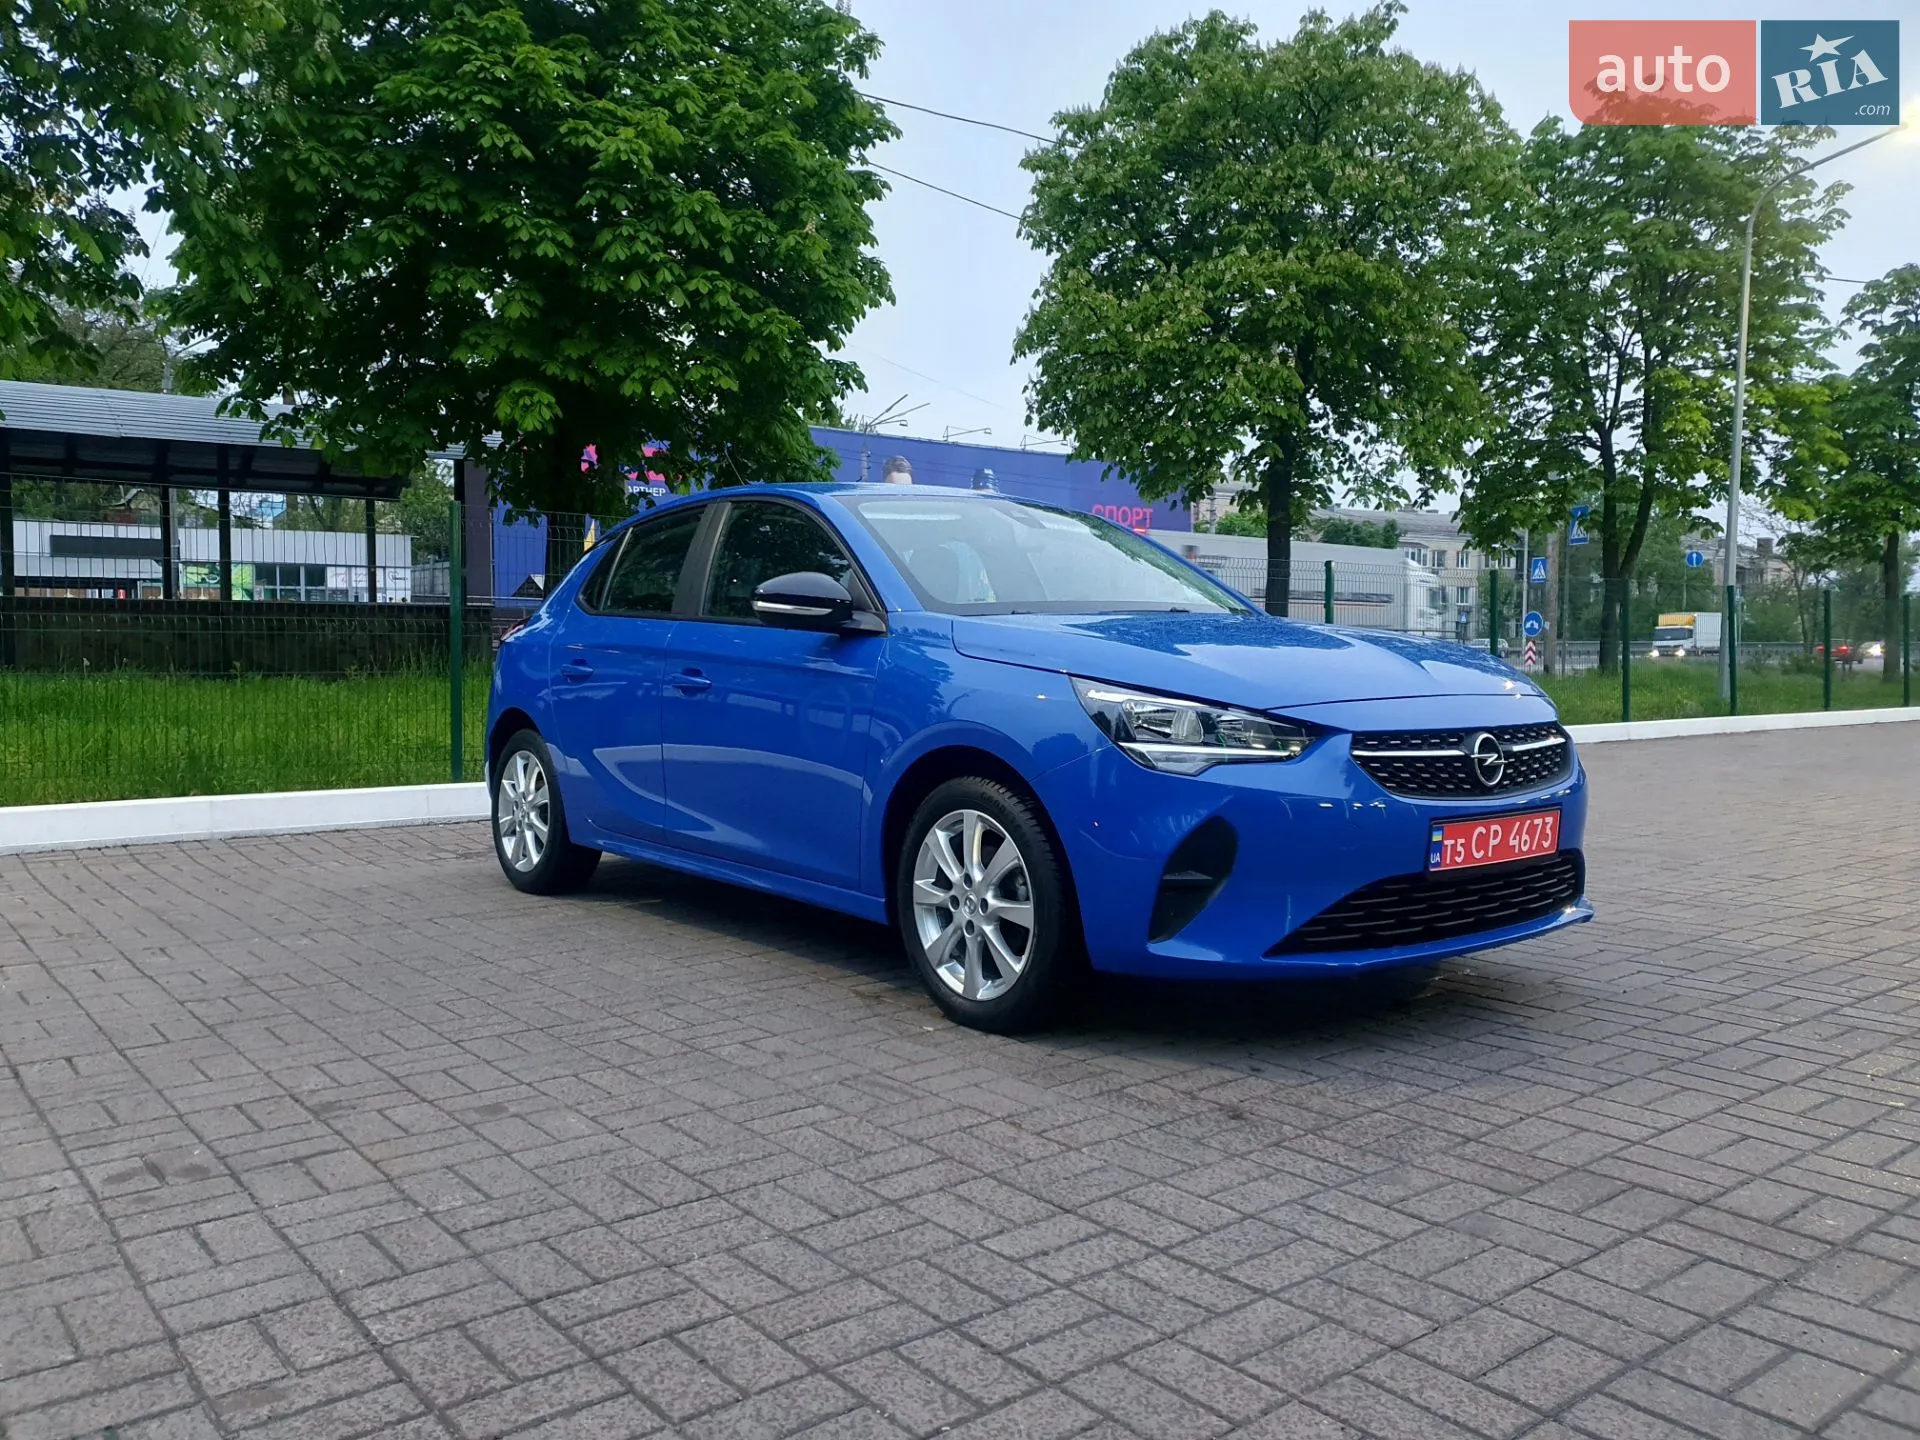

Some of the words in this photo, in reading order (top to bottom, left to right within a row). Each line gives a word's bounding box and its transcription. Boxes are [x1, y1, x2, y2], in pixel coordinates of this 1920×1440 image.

[627, 485, 667, 497] АРТНЕР
[1444, 838, 1466, 865] T5
[1471, 824, 1503, 859] CP
[1509, 816, 1554, 853] 4673
[1430, 852, 1441, 864] UA
